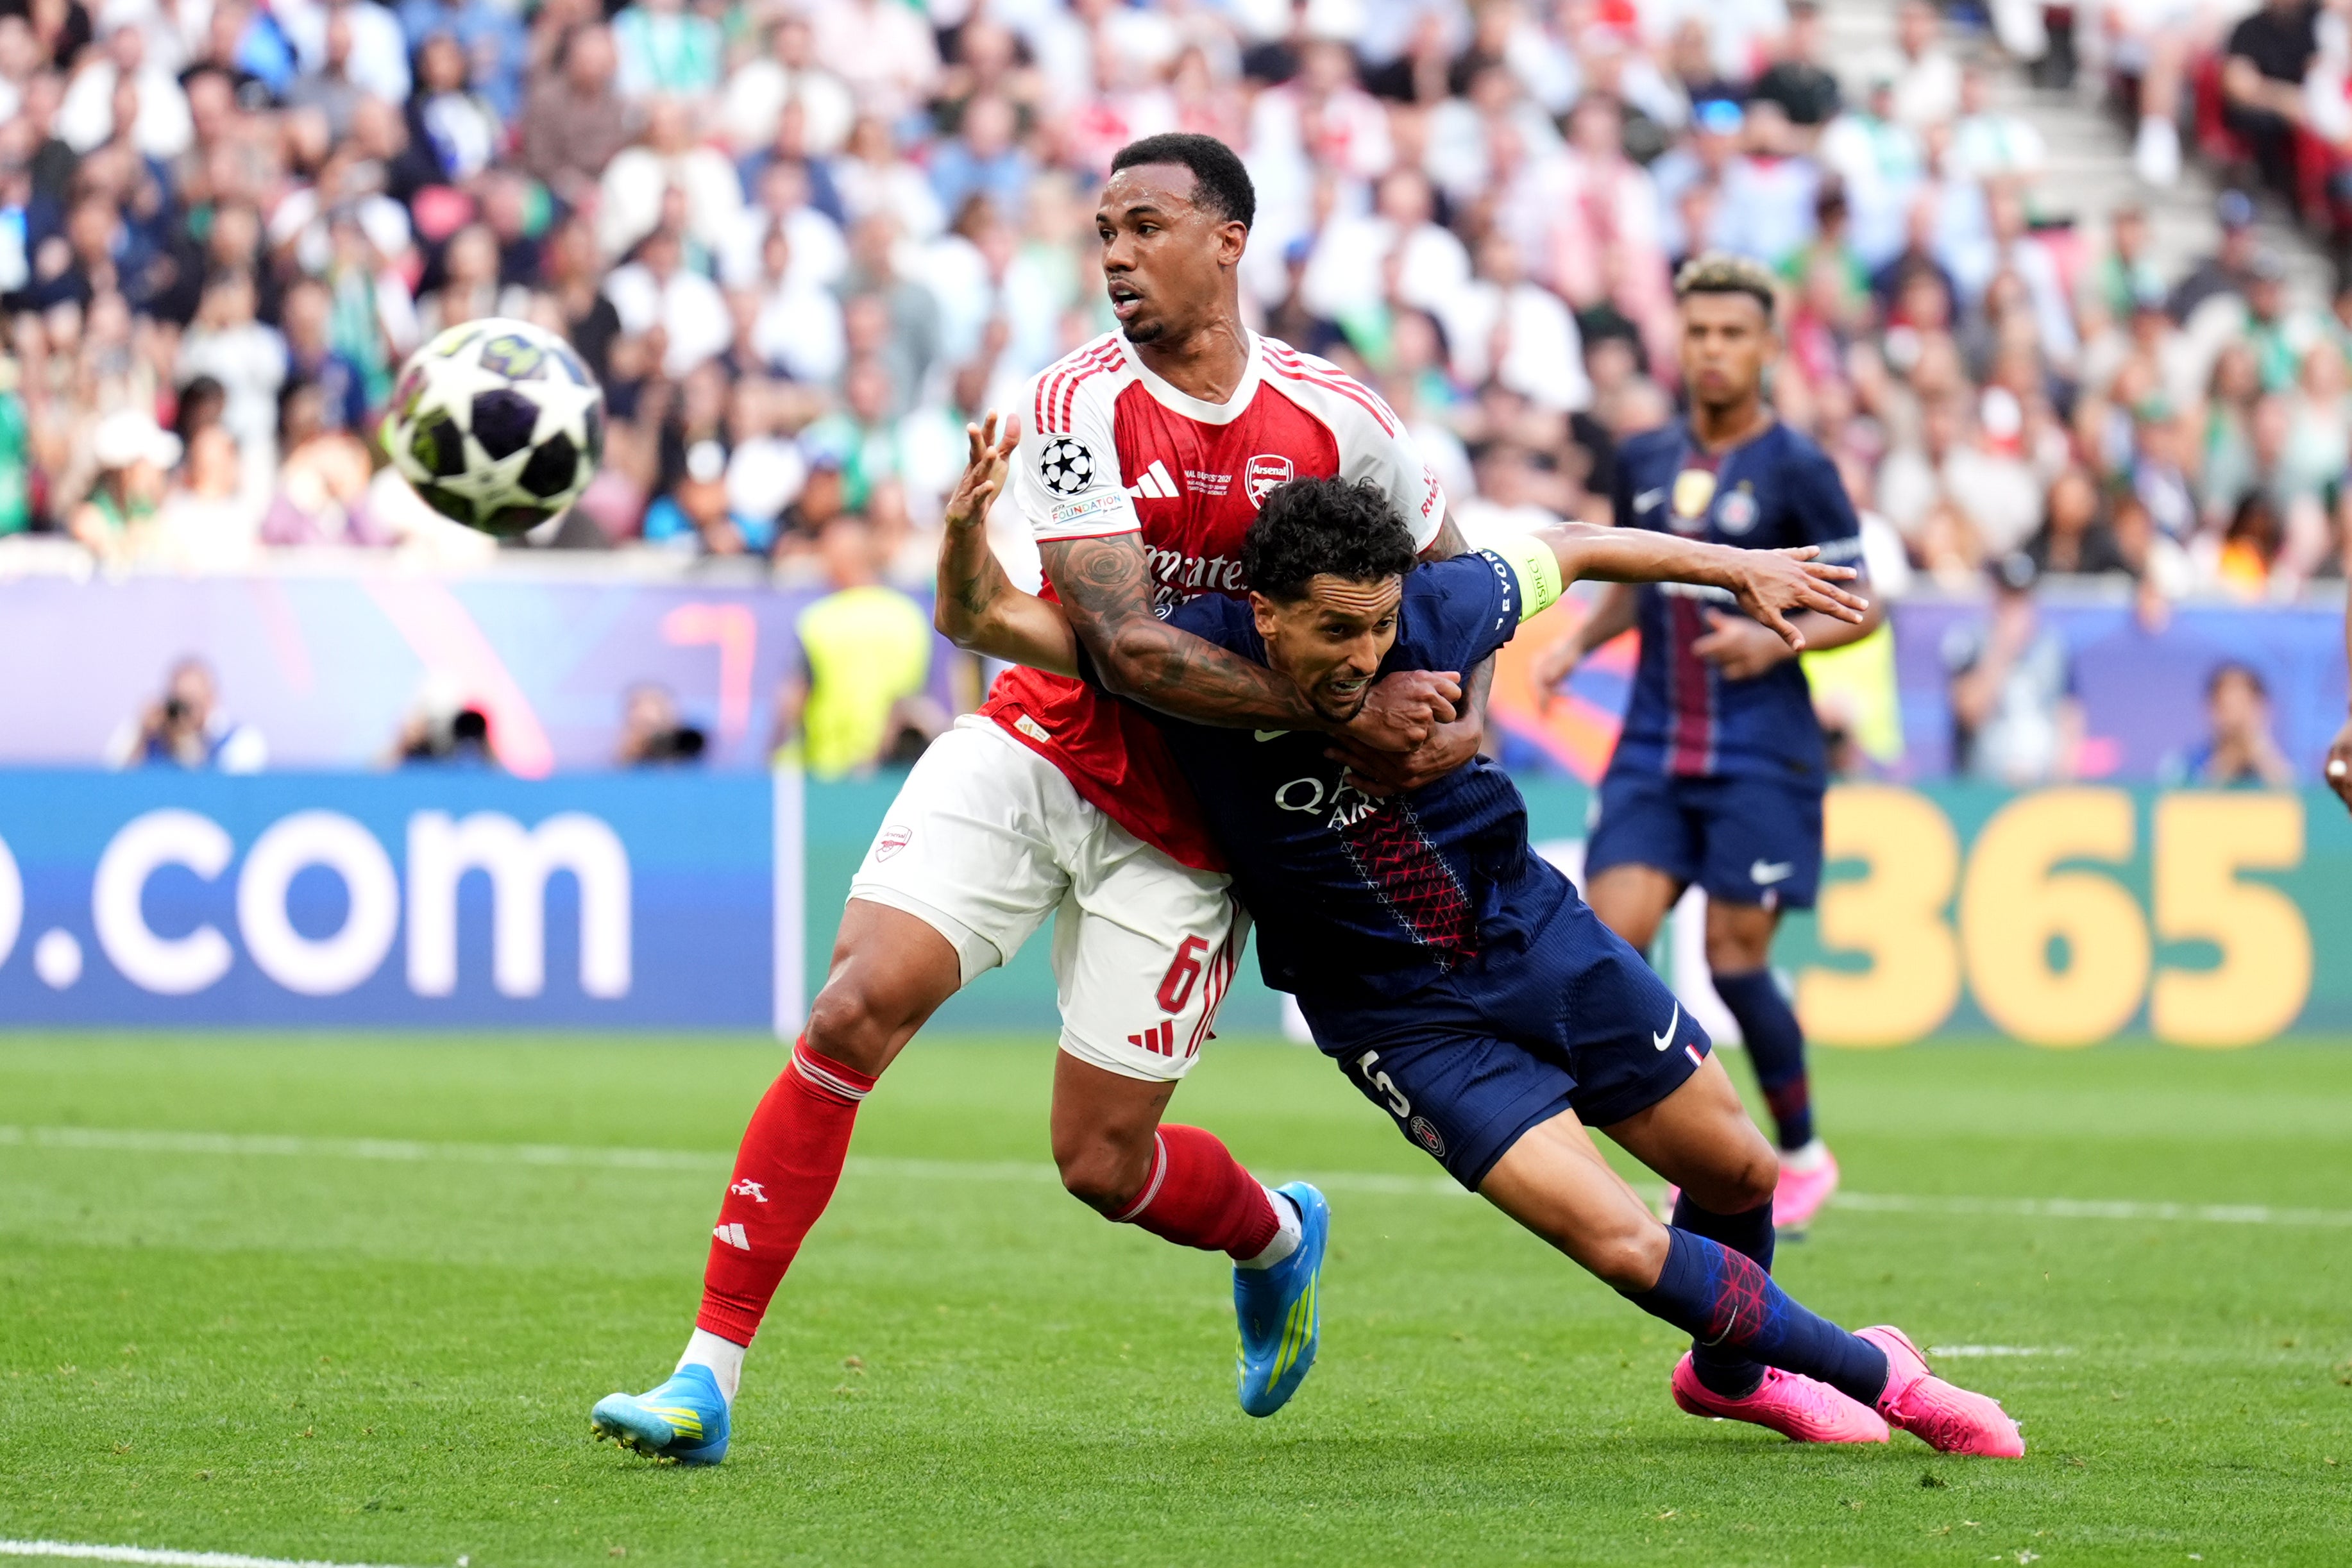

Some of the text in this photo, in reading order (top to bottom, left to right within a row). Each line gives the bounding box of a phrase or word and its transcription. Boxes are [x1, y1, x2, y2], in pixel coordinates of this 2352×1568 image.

[1252, 464, 1287, 476] Arsenal
[1051, 503, 1065, 513] UEFA
[1052, 494, 1122, 523] FOUNDATION
[0, 807, 632, 999] .com
[1155, 933, 1210, 1015] 6
[1356, 1049, 1410, 1118] 5
